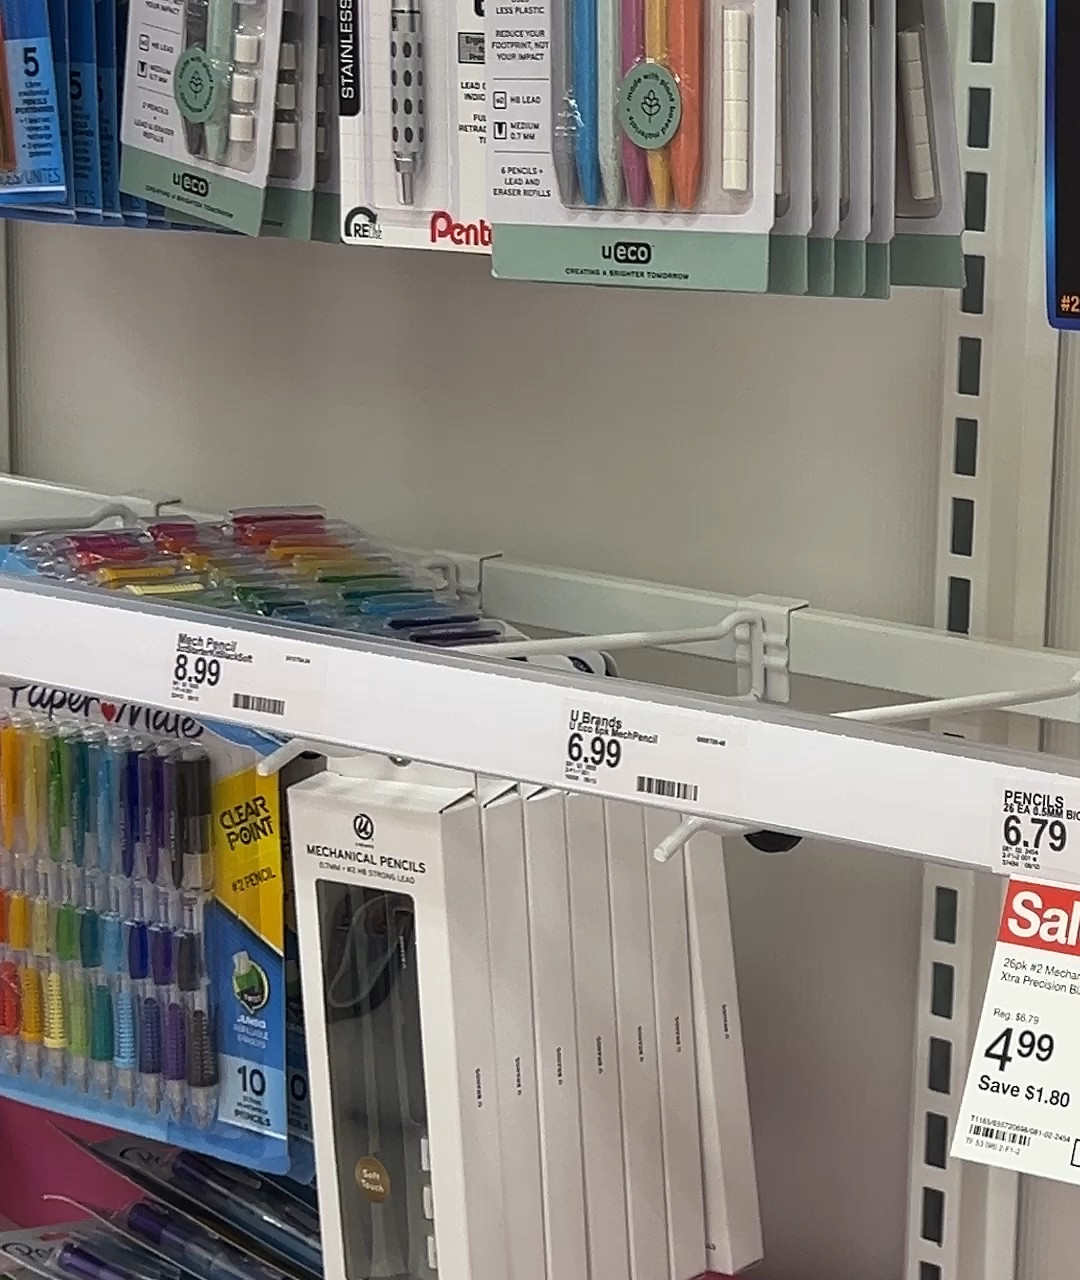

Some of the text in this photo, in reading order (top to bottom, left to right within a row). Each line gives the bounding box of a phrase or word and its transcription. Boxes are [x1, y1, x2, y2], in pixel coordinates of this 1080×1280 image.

[23, 47, 39, 77] 5
[510, 122, 539, 130] MEDIUM
[1060, 296, 1080, 312] #2
[178, 633, 237, 652] Mech Pencil
[175, 654, 220, 686] 8.99
[582, 711, 622, 729] Brands
[568, 733, 621, 768] 6.99
[1005, 790, 1064, 808] PENCILS
[1018, 805, 1030, 814] EA
[220, 795, 270, 830] CLEAR
[227, 815, 275, 850] POINT
[1003, 815, 1067, 852] 6.79
[306, 844, 426, 873] MECHANICAL PENCILS
[245, 867, 276, 889] PENCIL
[368, 870, 415, 884] STRONG LEAD
[1003, 958, 1027, 971] 26pk
[1000, 972, 1021, 984] Xtra
[1023, 976, 1067, 993] Precision
[1015, 1012, 1039, 1025] $6.79
[237, 1065, 266, 1096] 10
[978, 1075, 1070, 1108] Save $1.80
[361, 1168, 380, 1182] Soft
